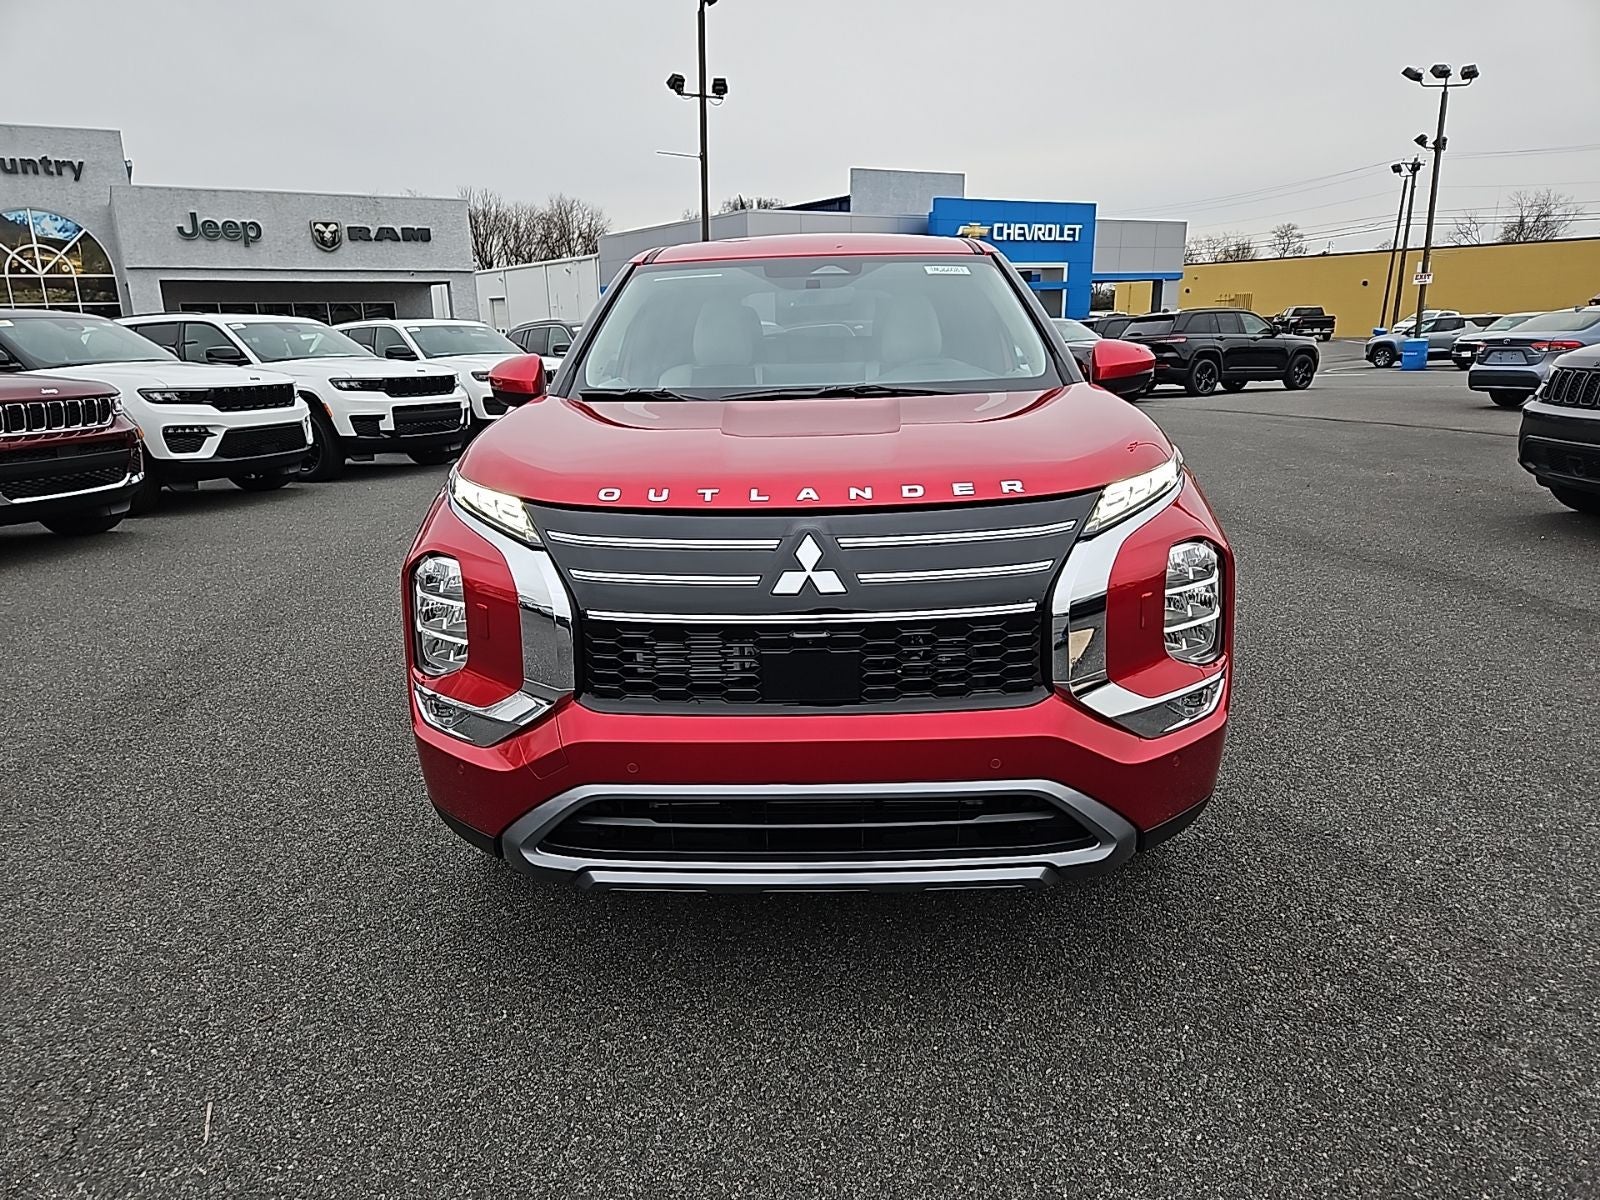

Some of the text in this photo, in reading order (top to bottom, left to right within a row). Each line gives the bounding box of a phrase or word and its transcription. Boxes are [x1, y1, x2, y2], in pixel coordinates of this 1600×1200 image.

[176, 212, 263, 248] Jeep
[346, 225, 432, 243] RAM
[992, 223, 1083, 242] CHEVROLET
[1414, 273, 1432, 281] EXIT
[597, 480, 1025, 502] OUTLANDER
